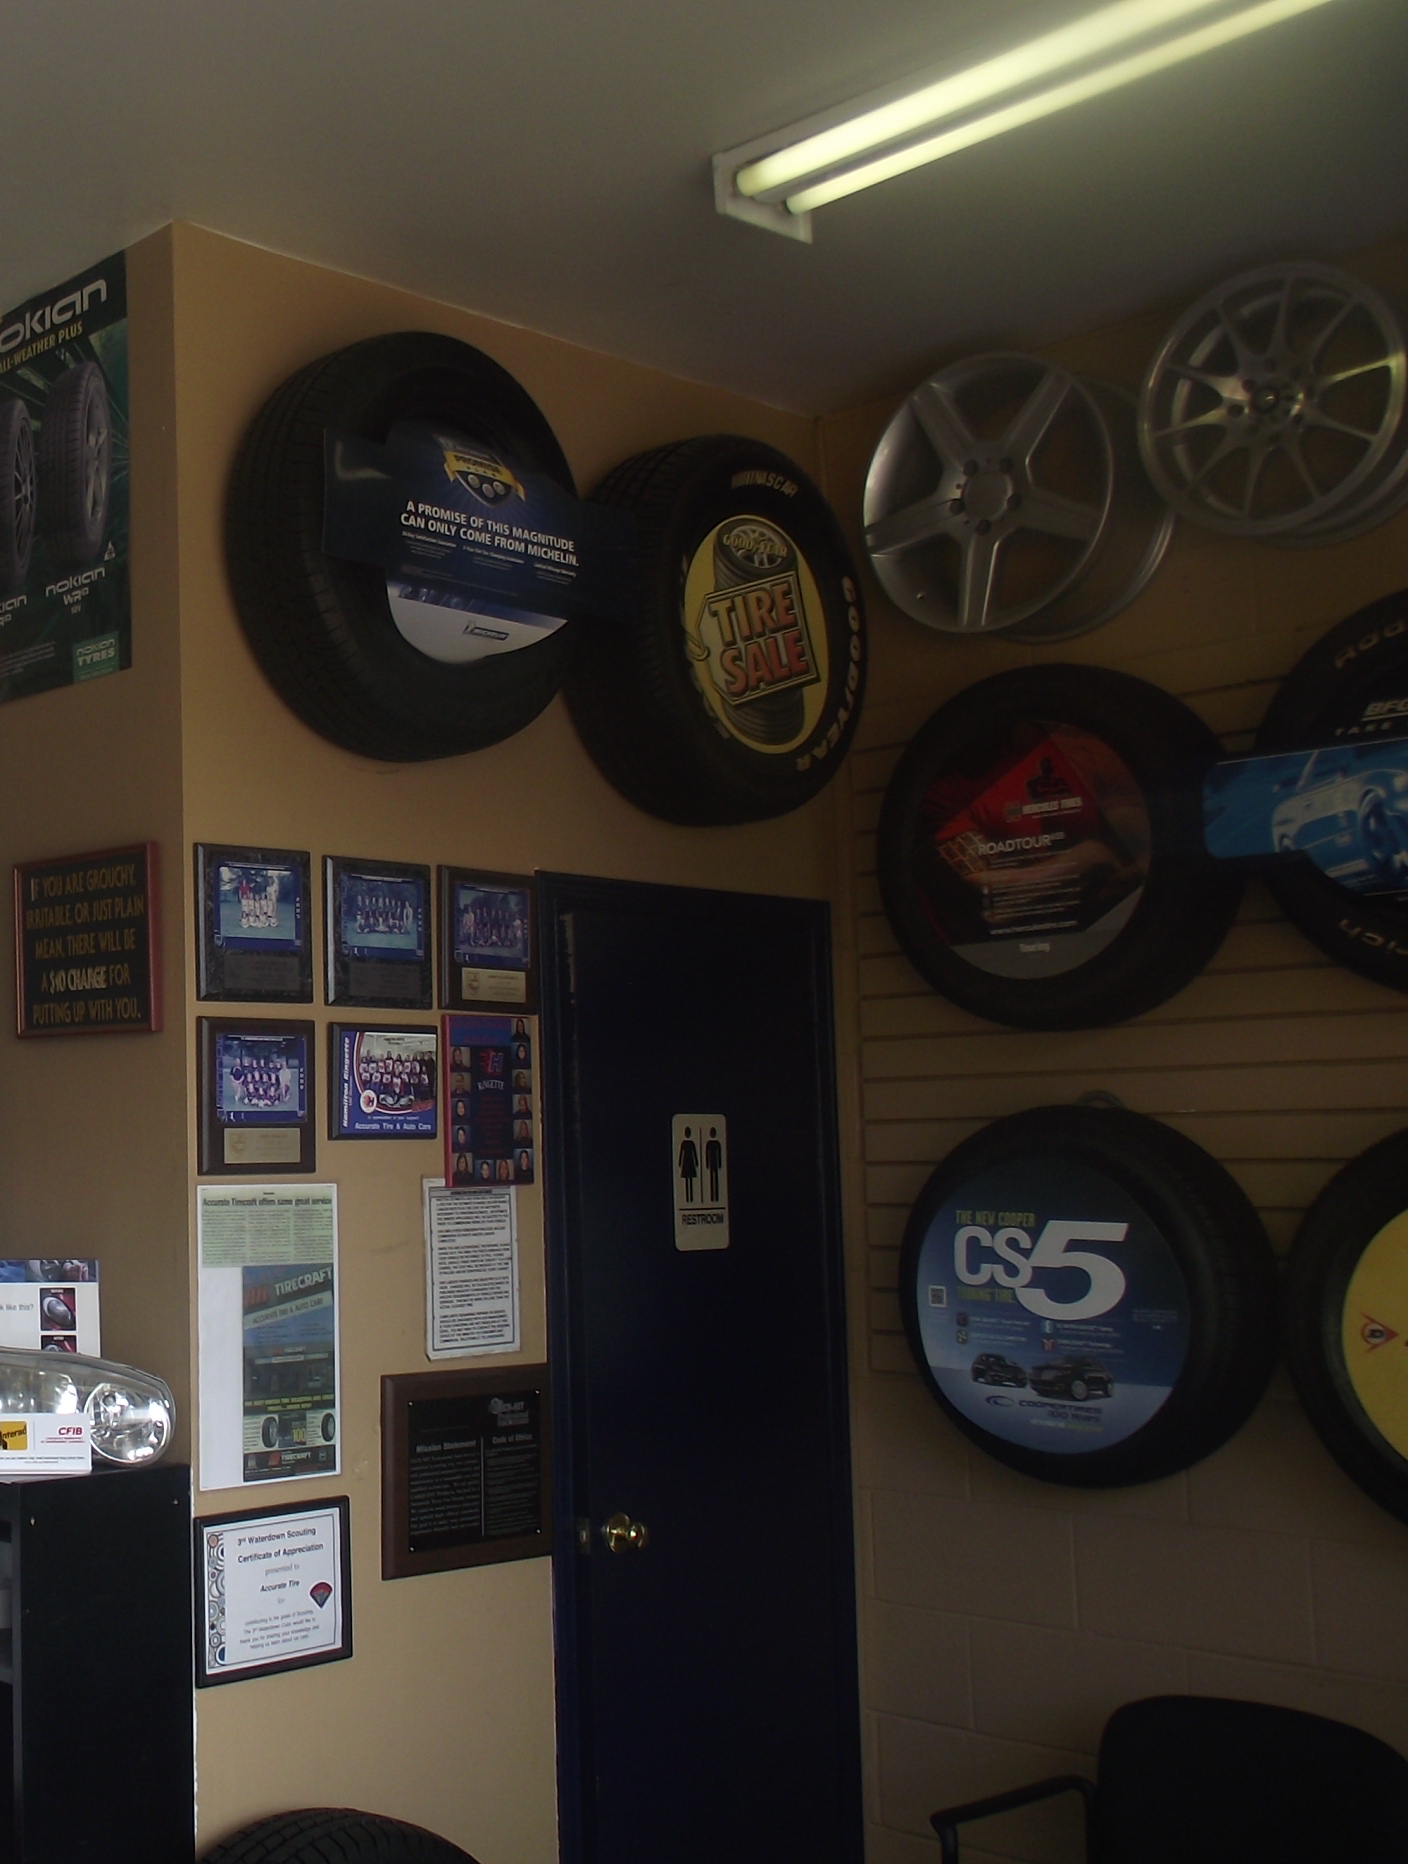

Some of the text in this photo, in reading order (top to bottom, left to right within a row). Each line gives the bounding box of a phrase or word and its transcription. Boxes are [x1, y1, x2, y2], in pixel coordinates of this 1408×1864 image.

[58, 321, 83, 344] PLUS
[406, 500, 576, 553] A PROMISE OF THIS MAGNITUDE
[400, 513, 425, 530] CAN
[428, 519, 458, 537] ONLY
[460, 527, 492, 546] COME
[494, 535, 526, 554] FROM
[527, 543, 581, 567] MICHELIN.
[709, 581, 798, 647] TIRE
[77, 647, 115, 667] TYRES
[719, 635, 810, 697] SALE
[977, 834, 1053, 856] ROADTOUR
[30, 877, 40, 901] IF
[44, 875, 63, 898] YOU
[65, 871, 84, 894] ARE
[75, 903, 89, 924] OR
[92, 899, 112, 922] JUST
[114, 894, 145, 918] PLAIN
[67, 934, 95, 957] THERE
[98, 931, 122, 953] WILL
[124, 928, 136, 950] BE
[42, 963, 131, 995] A $10 CHARGE FOR
[33, 997, 141, 1026] PUTTING UP WITH YOU.
[355, 1122, 432, 1131] Accurate Tire & Auto Care
[203, 1198, 230, 1206] Accurate
[295, 1198, 310, 1206] great
[681, 1213, 724, 1226] RESTROOM
[956, 1210, 1036, 1227] THE NEW COOPER
[274, 1266, 333, 1296] TIRECRAFT
[953, 1219, 1130, 1321] CS5
[6, 1303, 17, 1311] like
[19, 1303, 34, 1311] this?
[58, 1427, 83, 1436] CFIB
[248, 1532, 286, 1544] Waterdown
[287, 1526, 317, 1539] Scouting
[238, 1542, 324, 1564] Certificate of Appreciation
[260, 1579, 300, 1593] Accurate Tire
